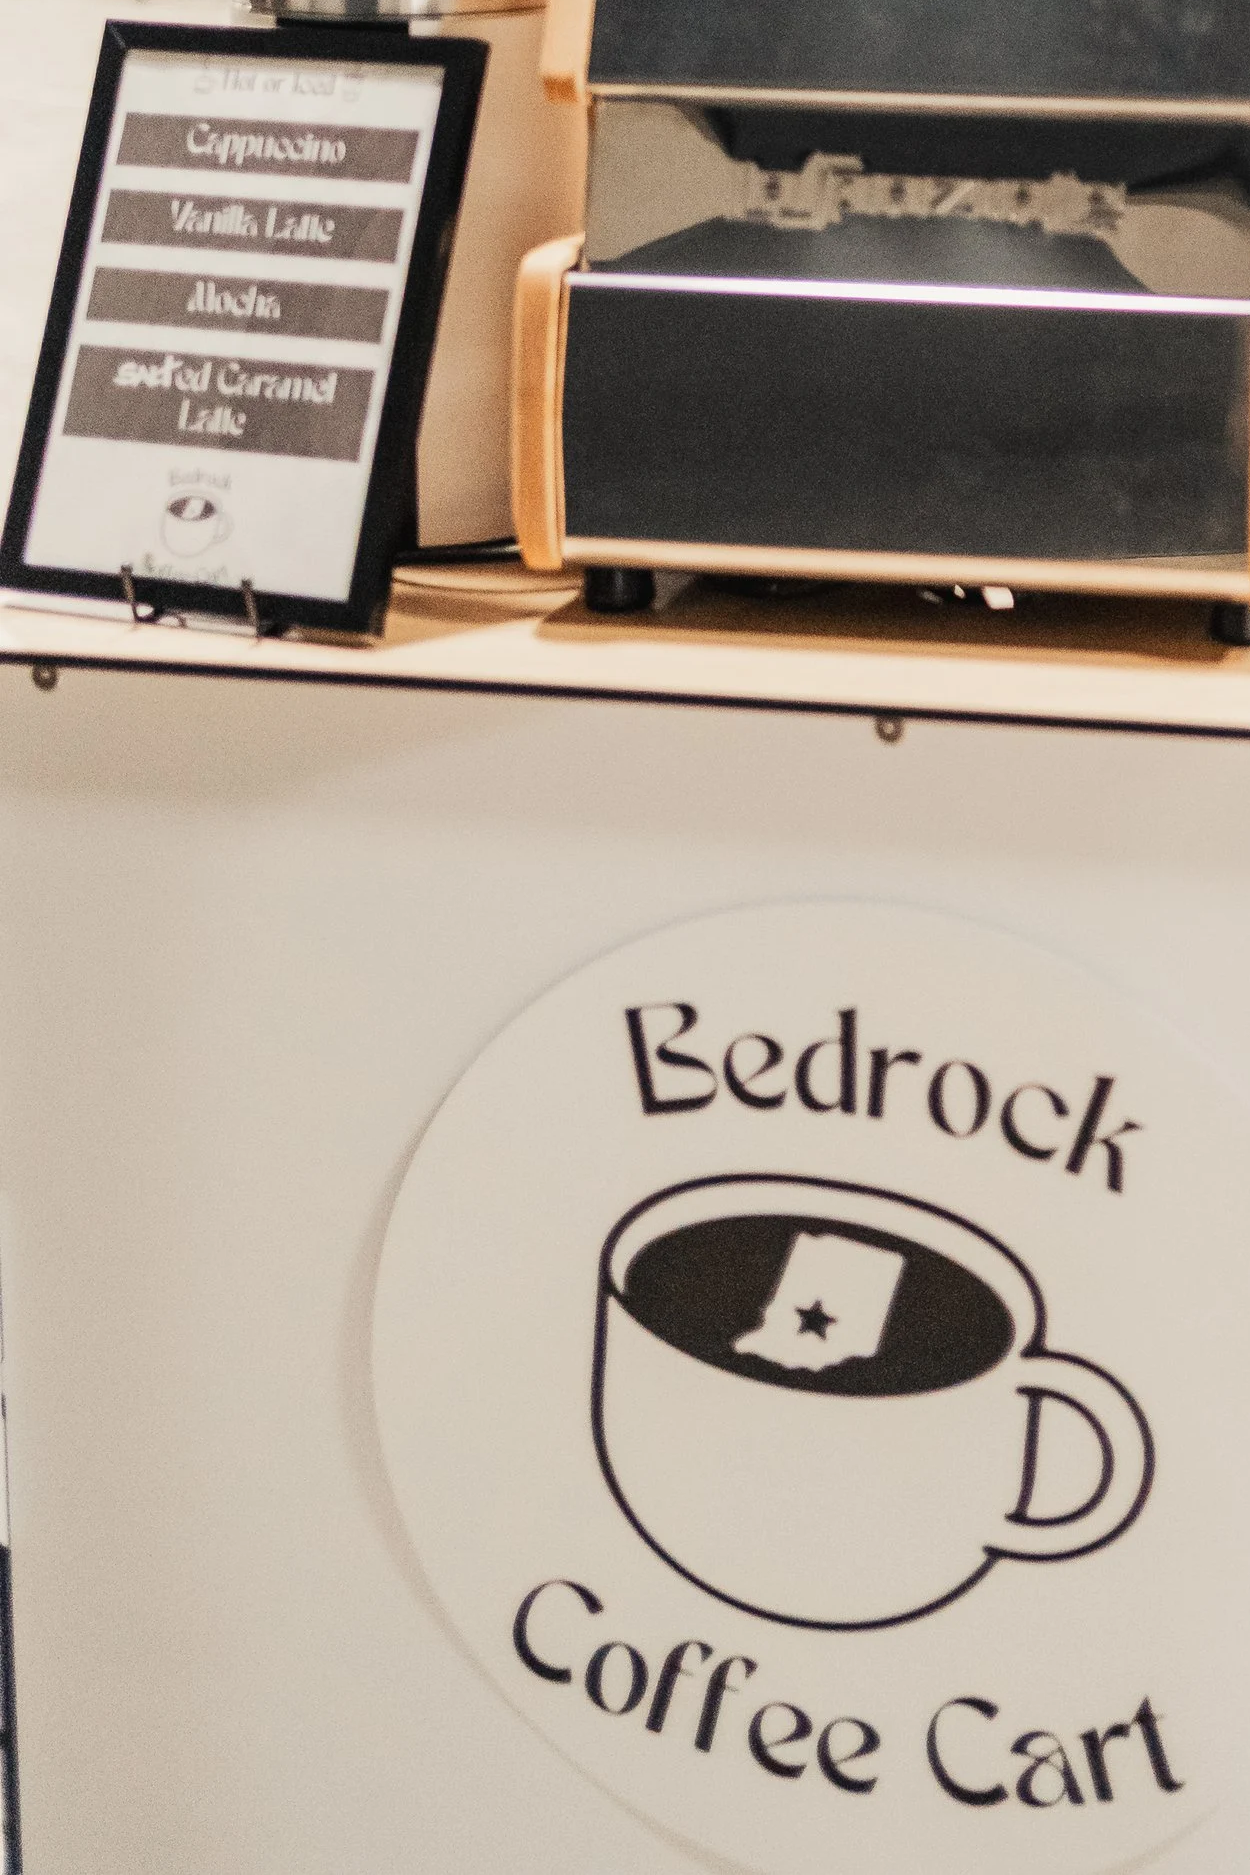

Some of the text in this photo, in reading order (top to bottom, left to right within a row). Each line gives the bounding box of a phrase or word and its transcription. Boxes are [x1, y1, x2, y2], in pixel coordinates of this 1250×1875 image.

[186, 123, 347, 166] Cappuccino
[171, 199, 336, 243] Vanilla Latte
[186, 280, 281, 319] Mocha
[216, 361, 338, 404] Caramel
[178, 398, 247, 437] Latte
[623, 1001, 1143, 1195] Bedrock
[511, 1579, 1185, 1808] Coffee Cart
